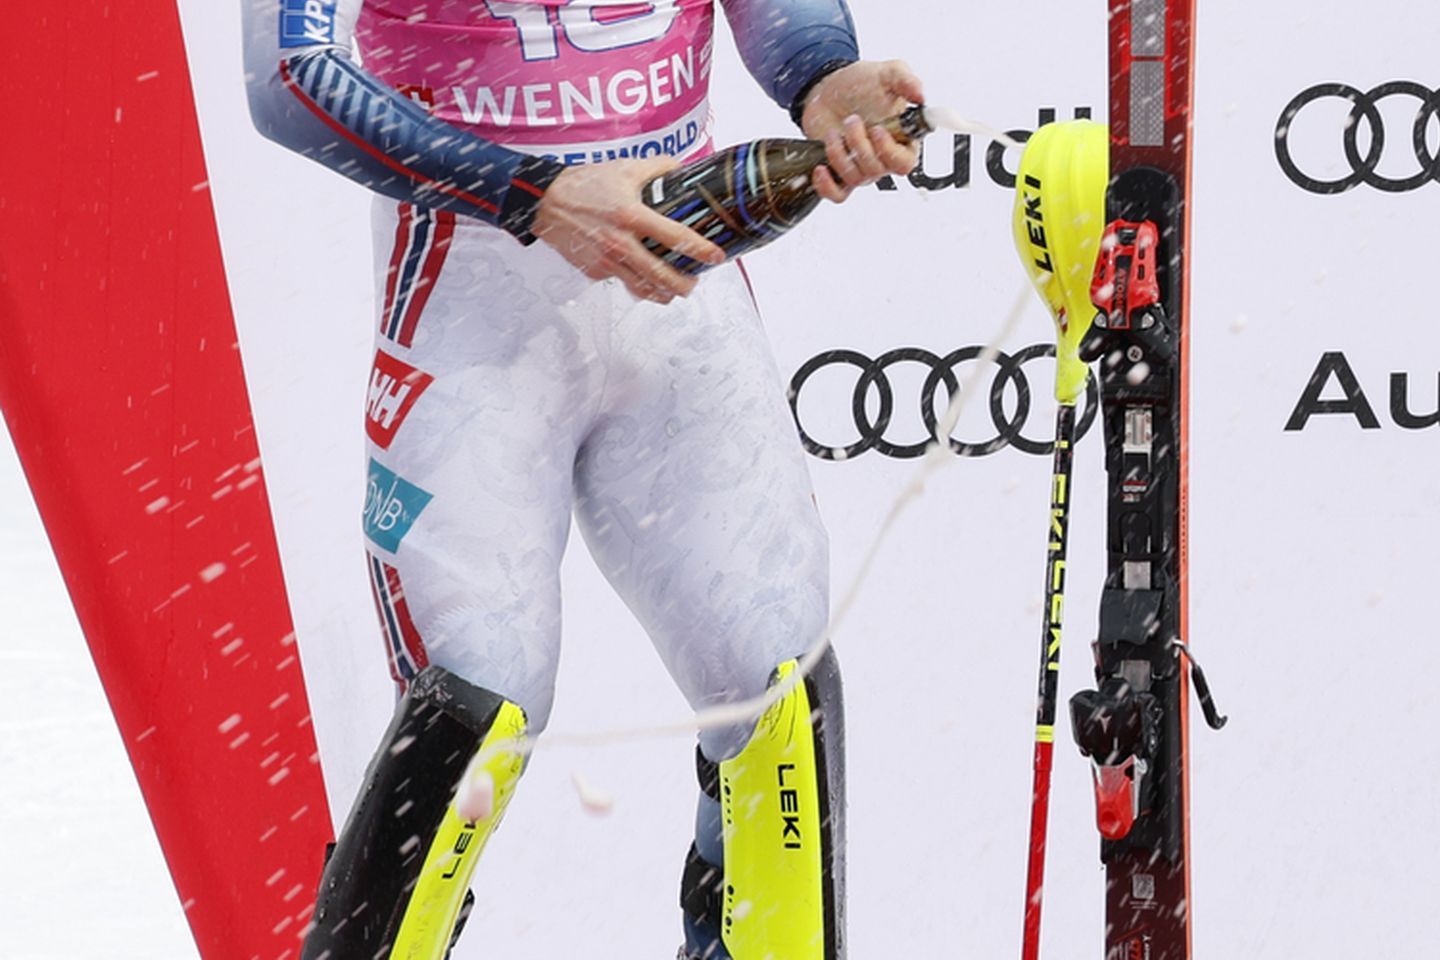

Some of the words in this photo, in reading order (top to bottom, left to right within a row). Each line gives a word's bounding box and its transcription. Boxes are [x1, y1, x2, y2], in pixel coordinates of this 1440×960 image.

[454, 46, 695, 128] WENGEN
[1024, 174, 1055, 274] LEKI
[1047, 559, 1066, 670] LEKI
[777, 763, 801, 849] LEKI
